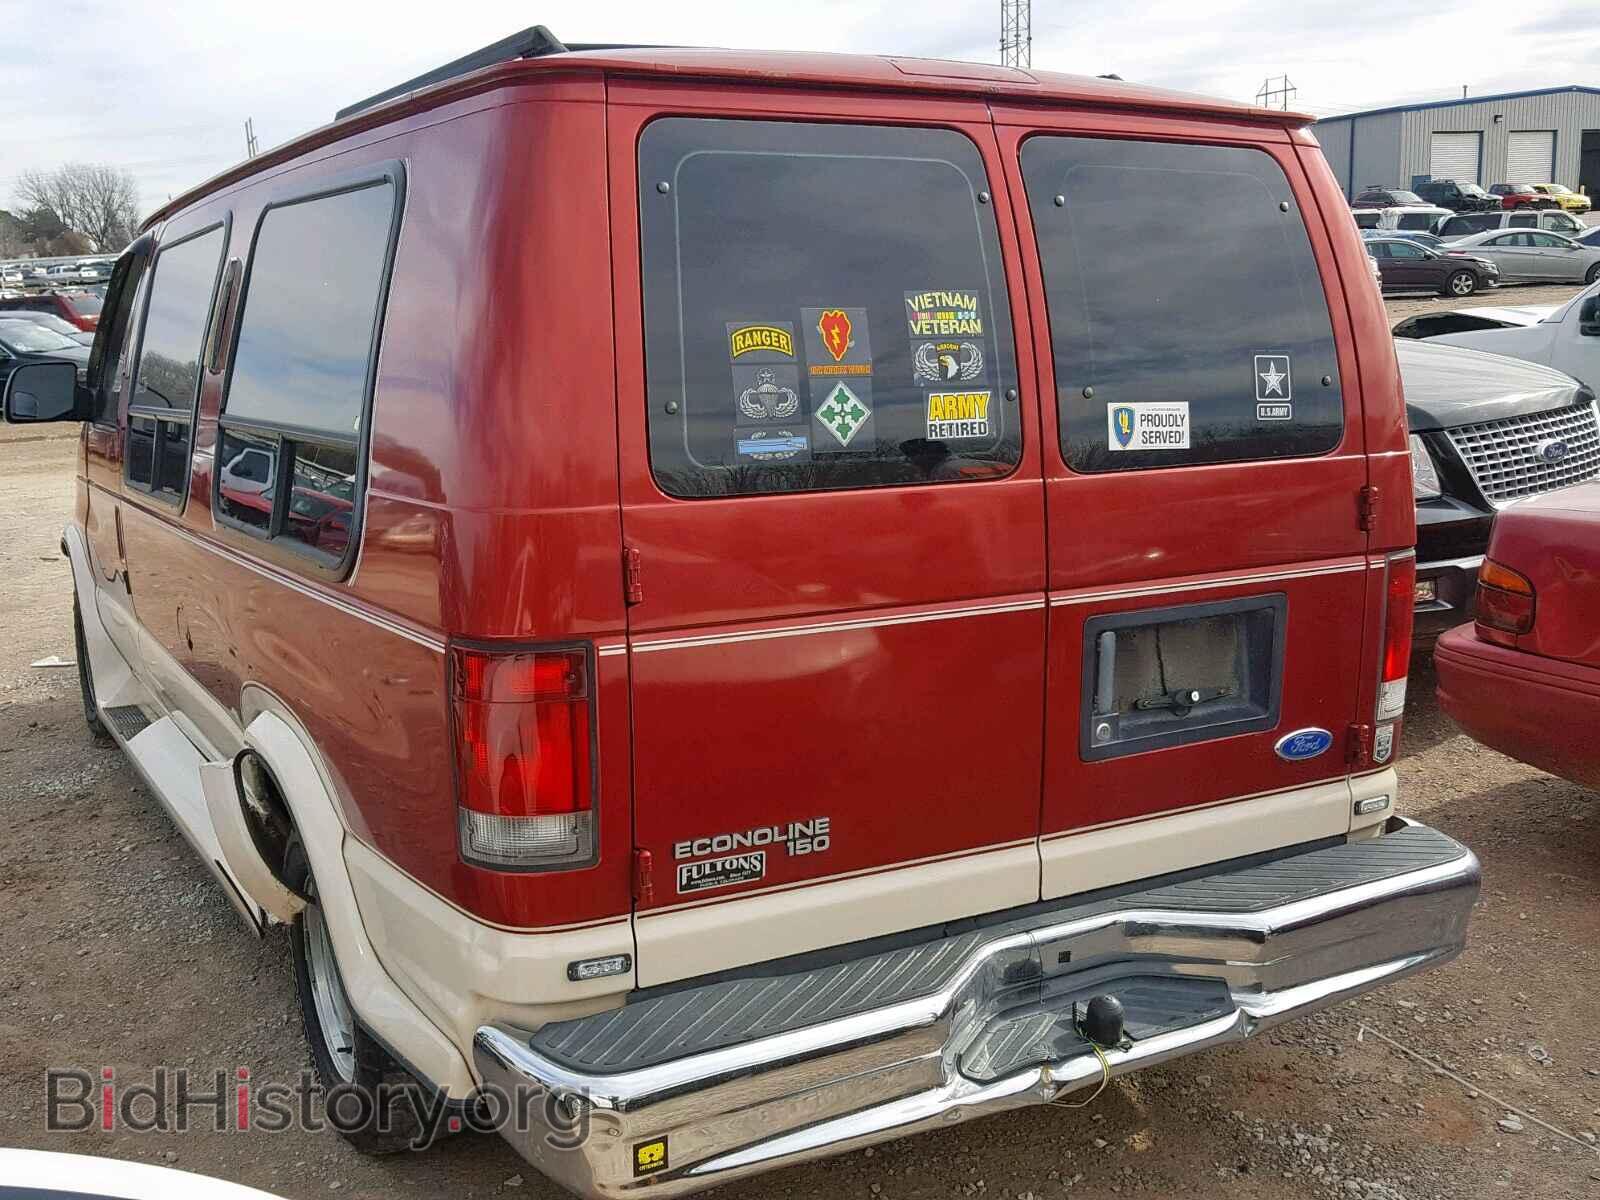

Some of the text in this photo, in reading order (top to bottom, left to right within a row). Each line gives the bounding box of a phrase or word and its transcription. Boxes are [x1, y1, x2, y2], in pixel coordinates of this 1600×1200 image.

[906, 292, 977, 311] VIETNAM
[910, 319, 983, 335] VETERAN
[735, 330, 788, 350] RANGER
[929, 393, 989, 421] ARMY
[928, 420, 988, 439] RETIRED
[1140, 413, 1185, 428] PROUDLY
[1141, 430, 1185, 445] SERVED!
[1290, 735, 1321, 753] Ford
[674, 816, 830, 860] ECONOLINE
[786, 835, 830, 857] 150
[681, 854, 762, 886] FULTONS
